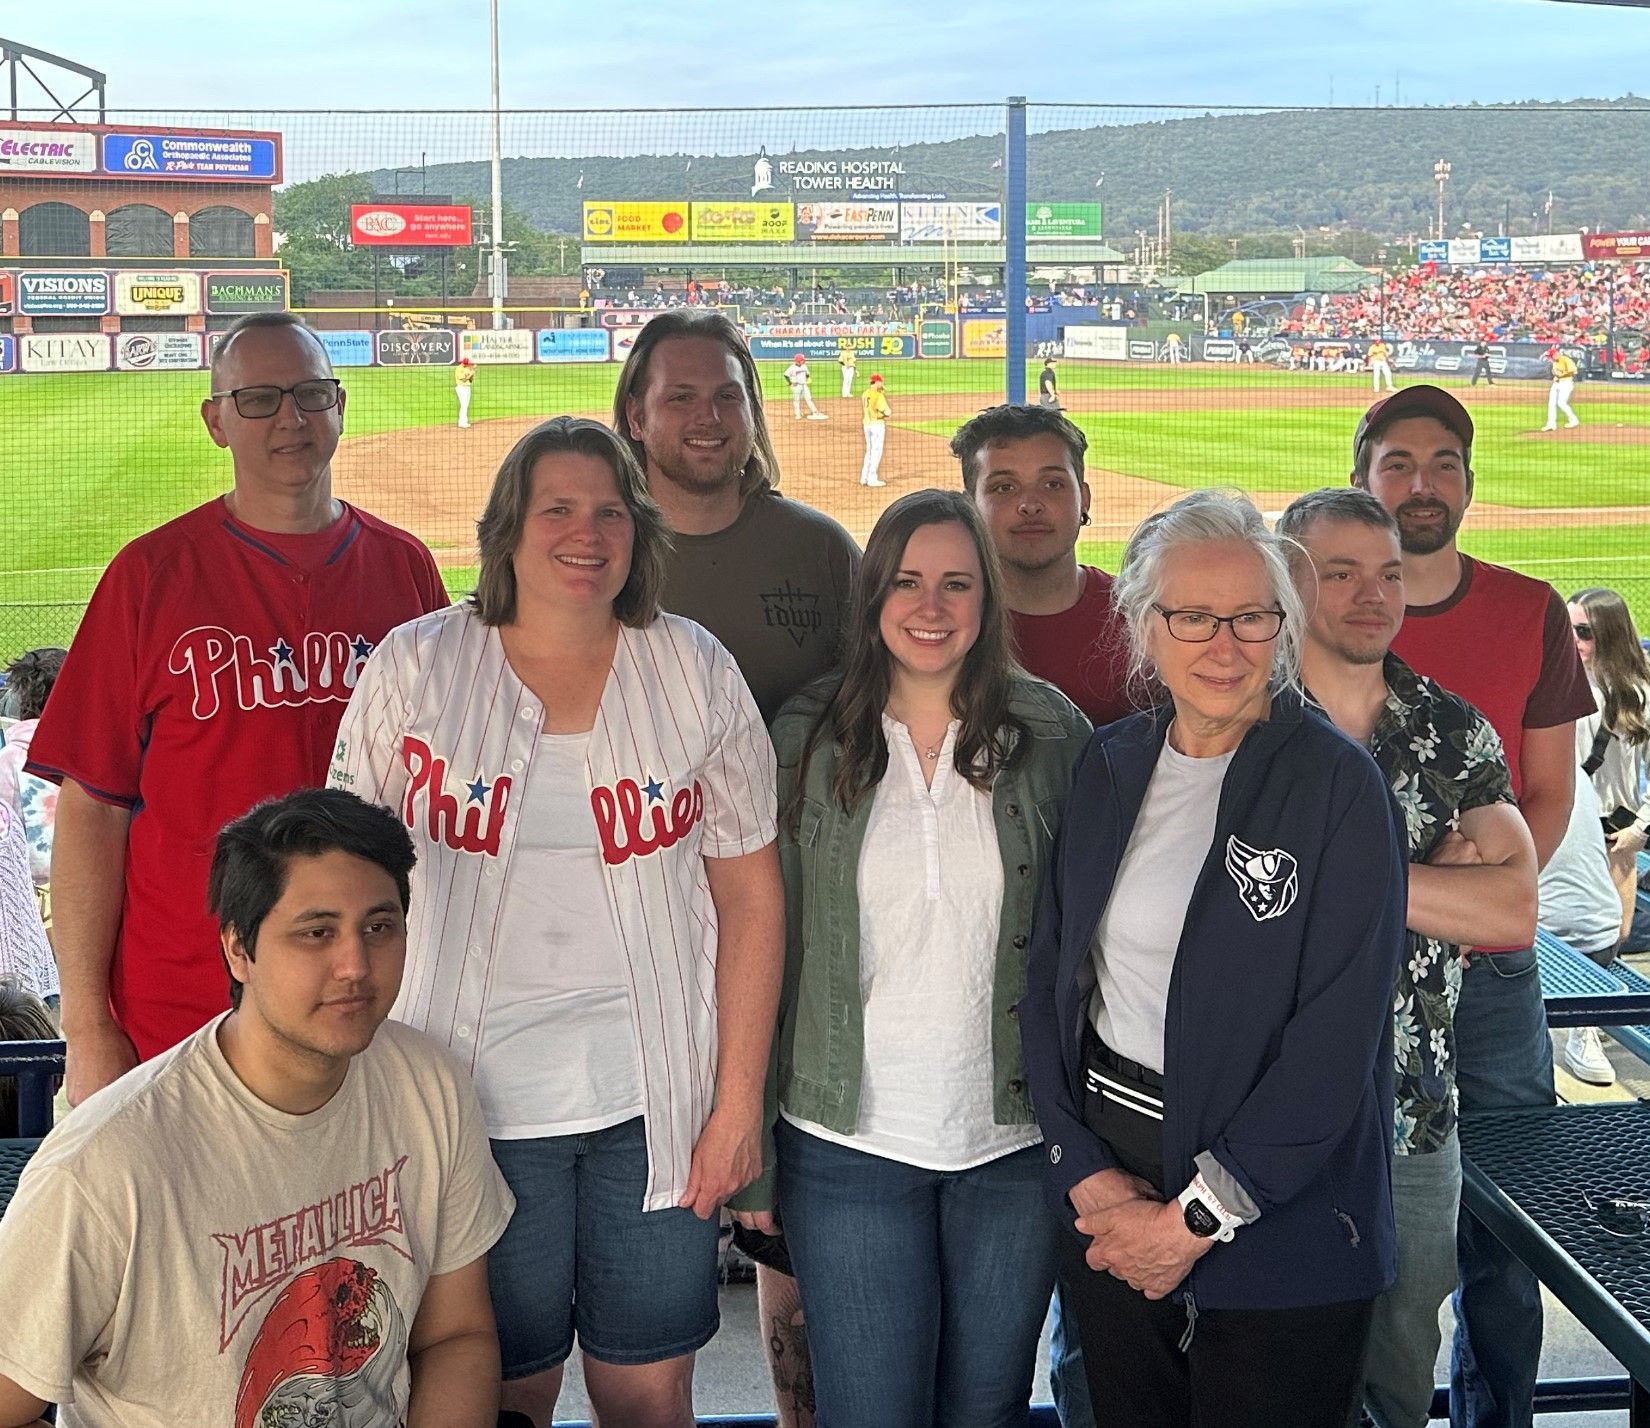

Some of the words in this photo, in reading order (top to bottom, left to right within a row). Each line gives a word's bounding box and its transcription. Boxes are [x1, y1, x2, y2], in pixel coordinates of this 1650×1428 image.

[1, 140, 74, 157] ELECTRIC
[162, 140, 251, 153] Commonwealth
[28, 158, 80, 166] CABLEVISION
[163, 152, 210, 161] Orthopaedic
[212, 153, 251, 162] Associates
[780, 161, 836, 174] READING
[841, 161, 906, 174] HOSPITAL
[793, 177, 842, 189] TOWER
[845, 177, 894, 189] HEALTH
[414, 214, 435, 222] Start
[617, 215, 641, 223] FOOD
[410, 223, 422, 231] go
[424, 223, 466, 231] anywhere
[1616, 236, 1637, 247] YOUR
[22, 278, 105, 292] VISIONS
[132, 287, 183, 302] UNIQUE
[769, 327, 826, 335] CHARACTER
[831, 327, 854, 335] POOL
[857, 326, 888, 335] PARTY
[481, 334, 513, 343] HALTER
[760, 340, 781, 348] When
[794, 340, 803, 348] all
[803, 340, 824, 348] about
[825, 340, 836, 348] the
[838, 337, 875, 350] RUSH
[28, 340, 99, 358] KITAY
[381, 341, 452, 353] DISCOVERY
[211, 1155, 416, 1354] METALLICA
